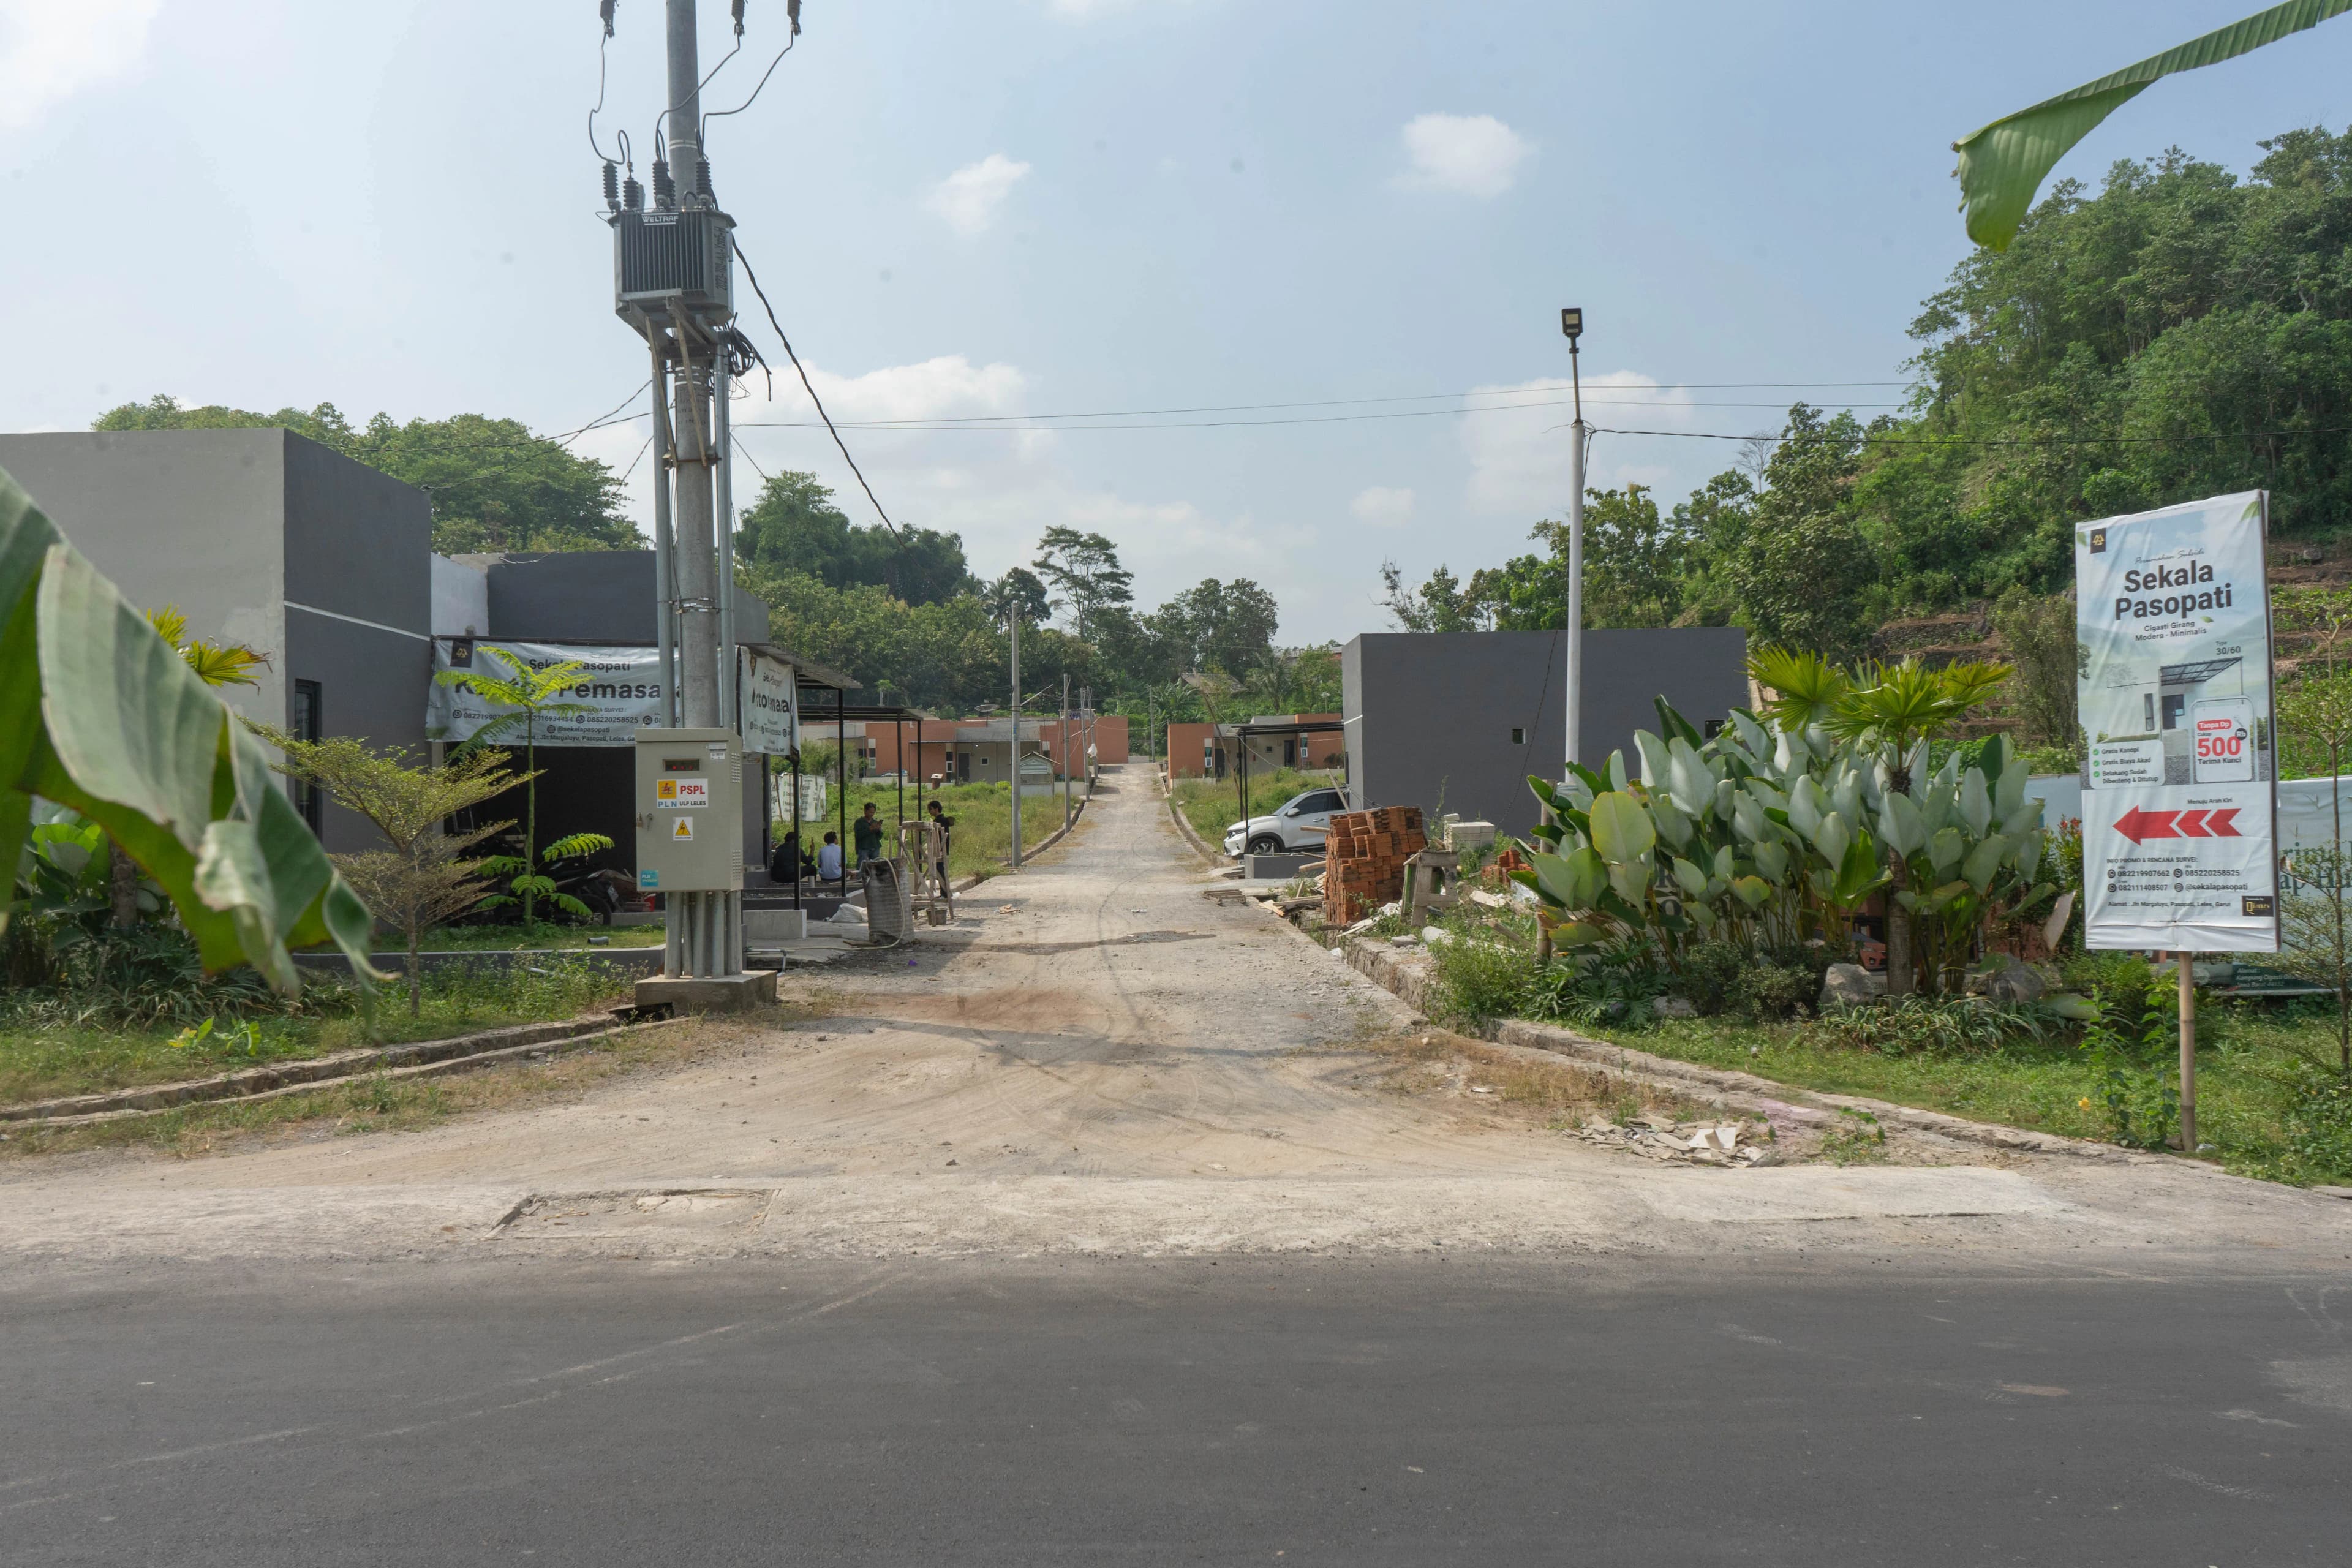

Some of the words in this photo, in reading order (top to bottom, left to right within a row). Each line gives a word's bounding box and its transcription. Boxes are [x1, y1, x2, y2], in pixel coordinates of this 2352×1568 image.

[2124, 560, 2214, 592] Sekala
[2116, 582, 2232, 620] Pasopati
[2144, 623, 2169, 632] Cigasti
[2170, 627, 2207, 637] Minimalis
[2216, 646, 2241, 655] 30/60
[573, 661, 630, 673] asopati
[2197, 736, 2241, 757] 500
[680, 786, 706, 794] PSPL
[2185, 883, 2248, 892] @sekalapasopati
